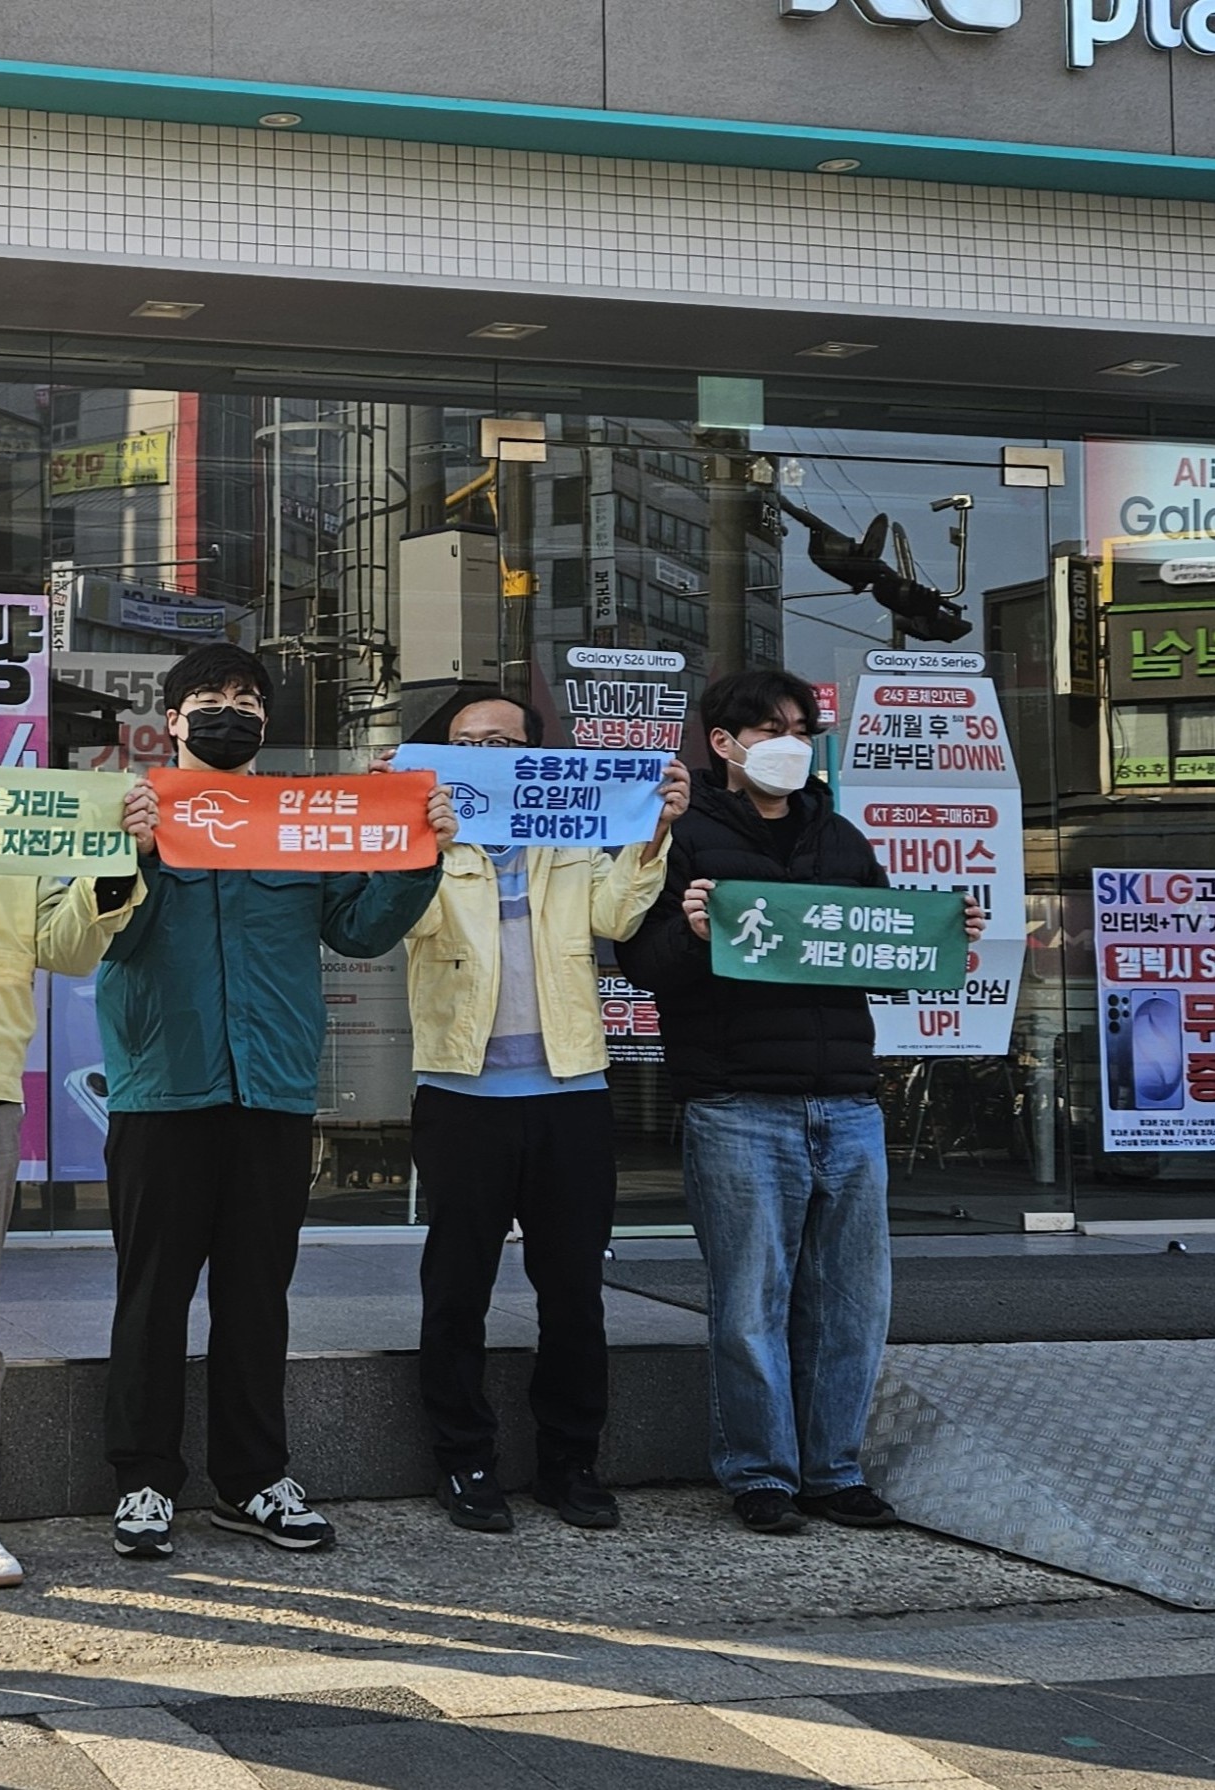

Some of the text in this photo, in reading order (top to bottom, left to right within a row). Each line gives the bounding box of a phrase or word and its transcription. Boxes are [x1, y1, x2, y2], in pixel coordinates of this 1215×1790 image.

[576, 652, 677, 667] Galaxy S26 Ultra
[874, 654, 978, 669] Galaxy S26 Series
[565, 680, 688, 719] 나에게는
[572, 718, 683, 750] 선명하게
[858, 714, 923, 738] 24개월
[929, 714, 949, 739] 후
[514, 755, 662, 782] 승용차 5부제
[853, 743, 1006, 771] 단말부담 DOWN!
[6, 789, 80, 818] 거리는
[279, 789, 358, 814] 안 쓰는
[513, 784, 601, 811] (요일제)
[510, 814, 607, 840] 참여하기
[872, 808, 990, 824] KT 초이스 구매하고
[1, 828, 75, 857] 자전거
[82, 831, 131, 857] 타기
[277, 824, 409, 851] 플러그 뽑기
[802, 904, 914, 934] 4층 이하는
[800, 940, 938, 971] 계단 이용하기
[1115, 947, 1192, 979] 갤럭시
[966, 980, 1010, 1005] 안심
[919, 1010, 960, 1036] UP!
